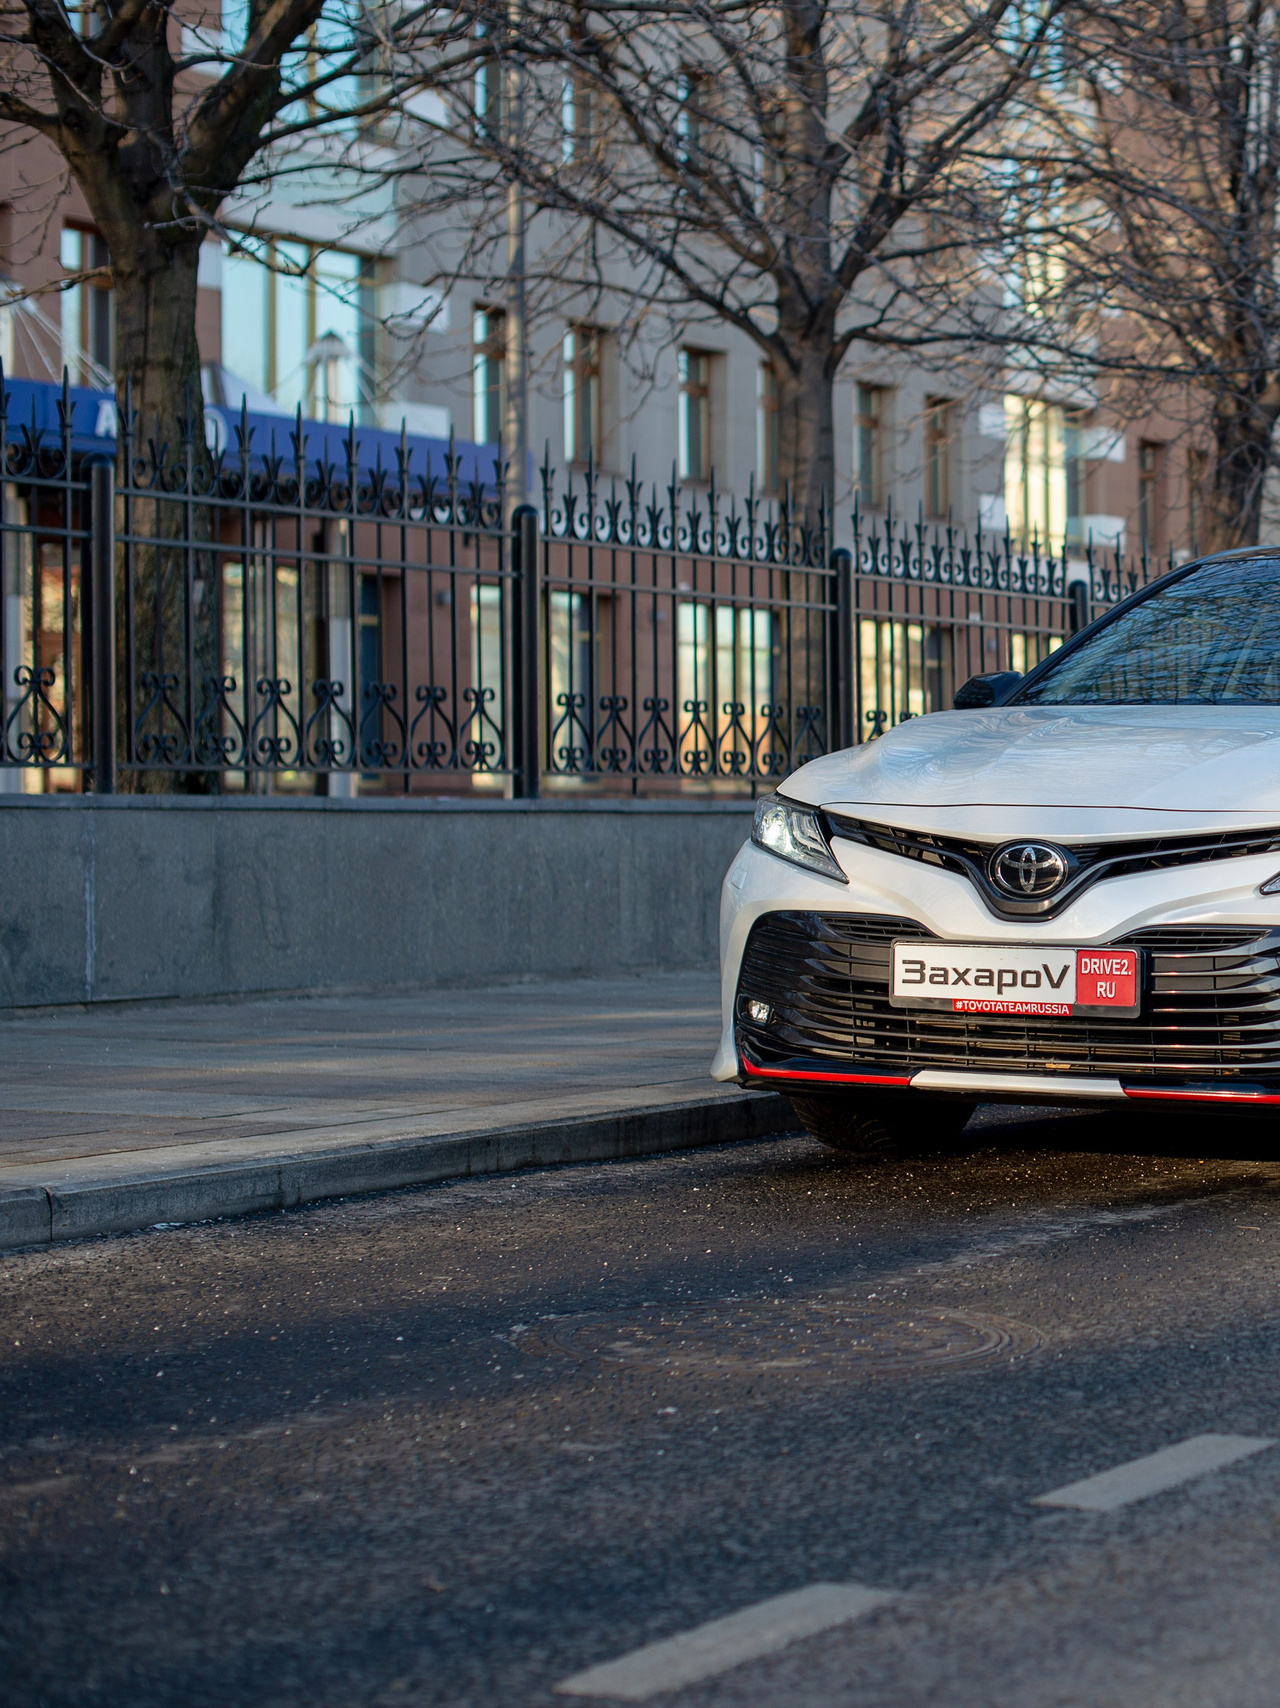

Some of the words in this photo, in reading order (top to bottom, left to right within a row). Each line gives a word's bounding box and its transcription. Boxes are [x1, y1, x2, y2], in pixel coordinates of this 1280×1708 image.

[1081, 958, 1132, 975] DRIVE2.
[1097, 981, 1116, 998] RU
[955, 1000, 1070, 1015] #TOYOTATEAMRUSSIA
